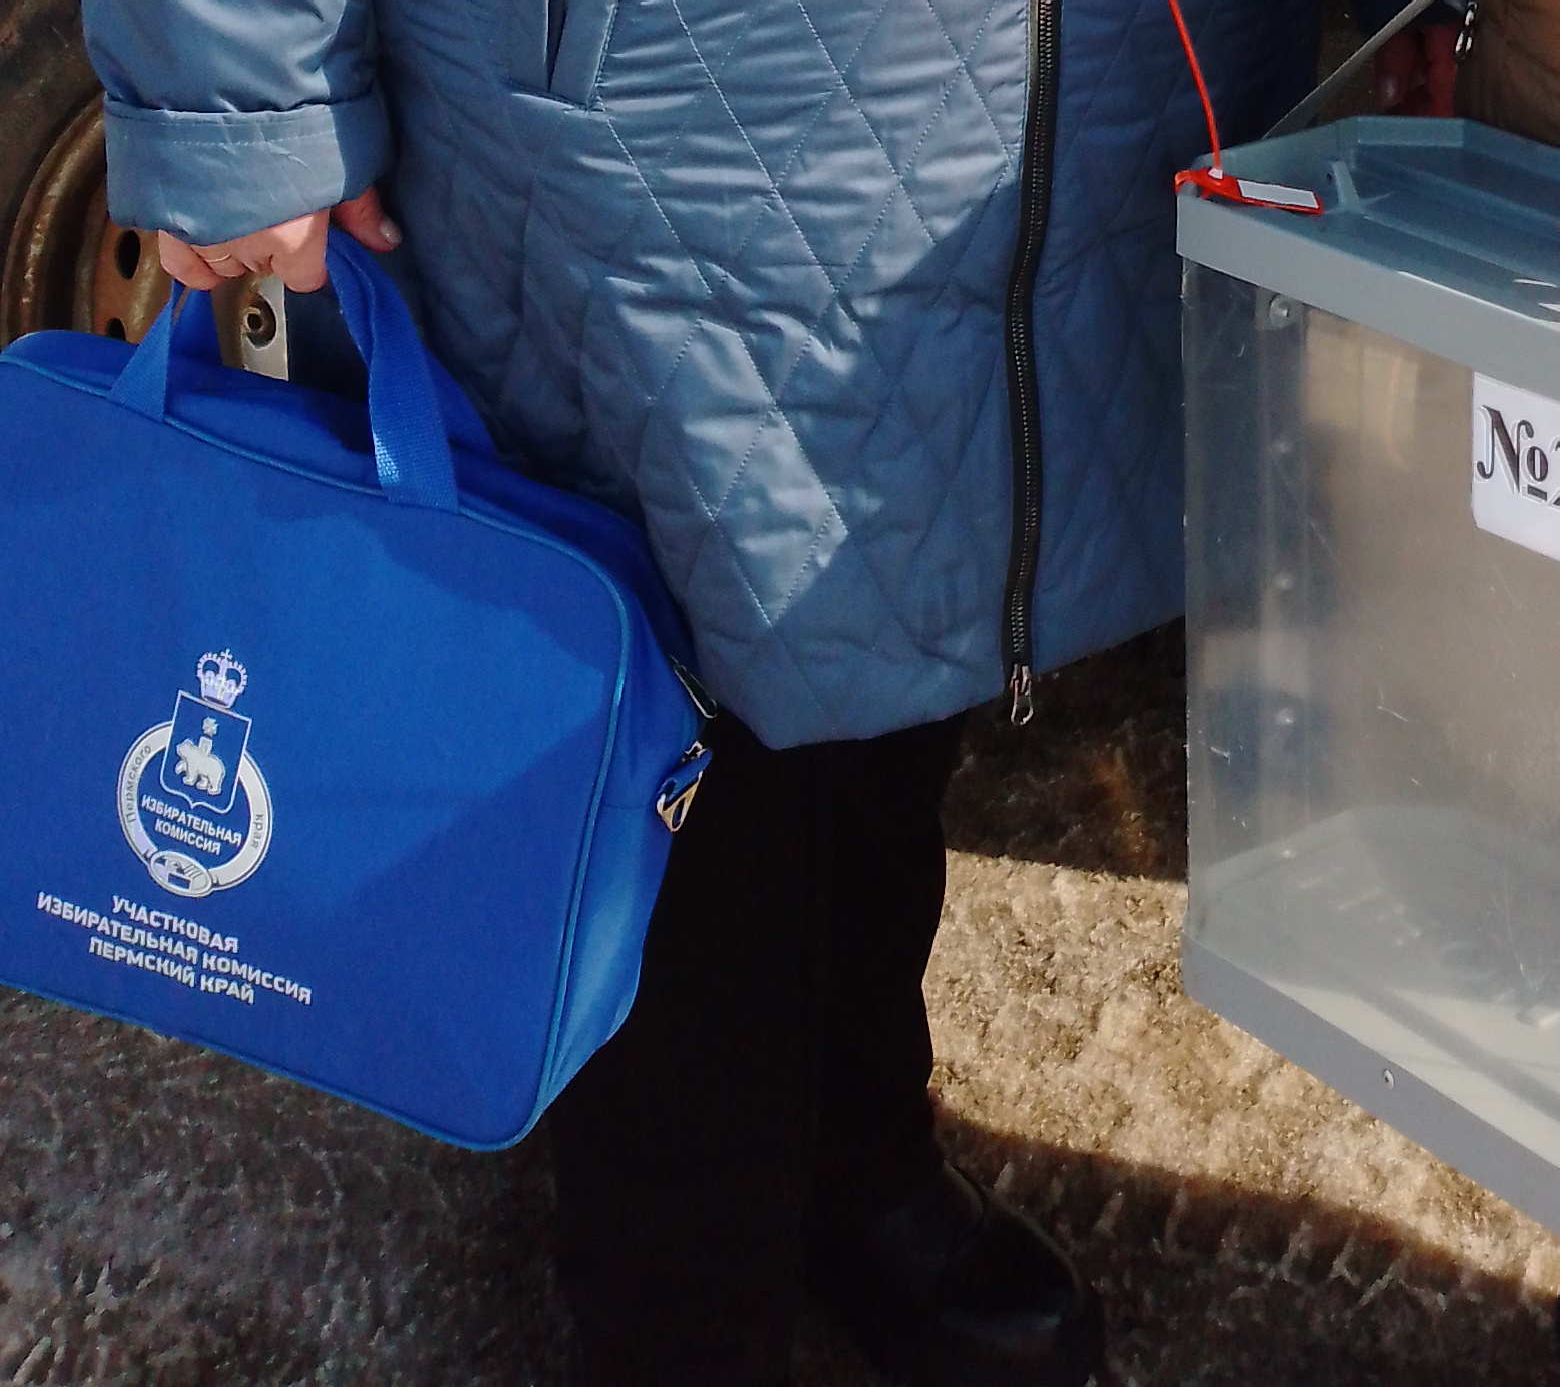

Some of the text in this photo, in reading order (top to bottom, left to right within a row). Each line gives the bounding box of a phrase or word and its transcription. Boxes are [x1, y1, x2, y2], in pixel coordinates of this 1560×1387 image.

[125, 744, 152, 823] Пермского
[141, 794, 242, 848] ИЗБИРАТЕЛЬНАЯ
[154, 818, 222, 856] КОМИССИЯ
[36, 891, 313, 1006] ИЗБИРАТЕЛЬНАЯ КОМИССИЯ
[112, 895, 239, 954] УЧАСТКОВАЯ
[88, 935, 256, 1005] ПЕРМСКИЙ КРАЙ
